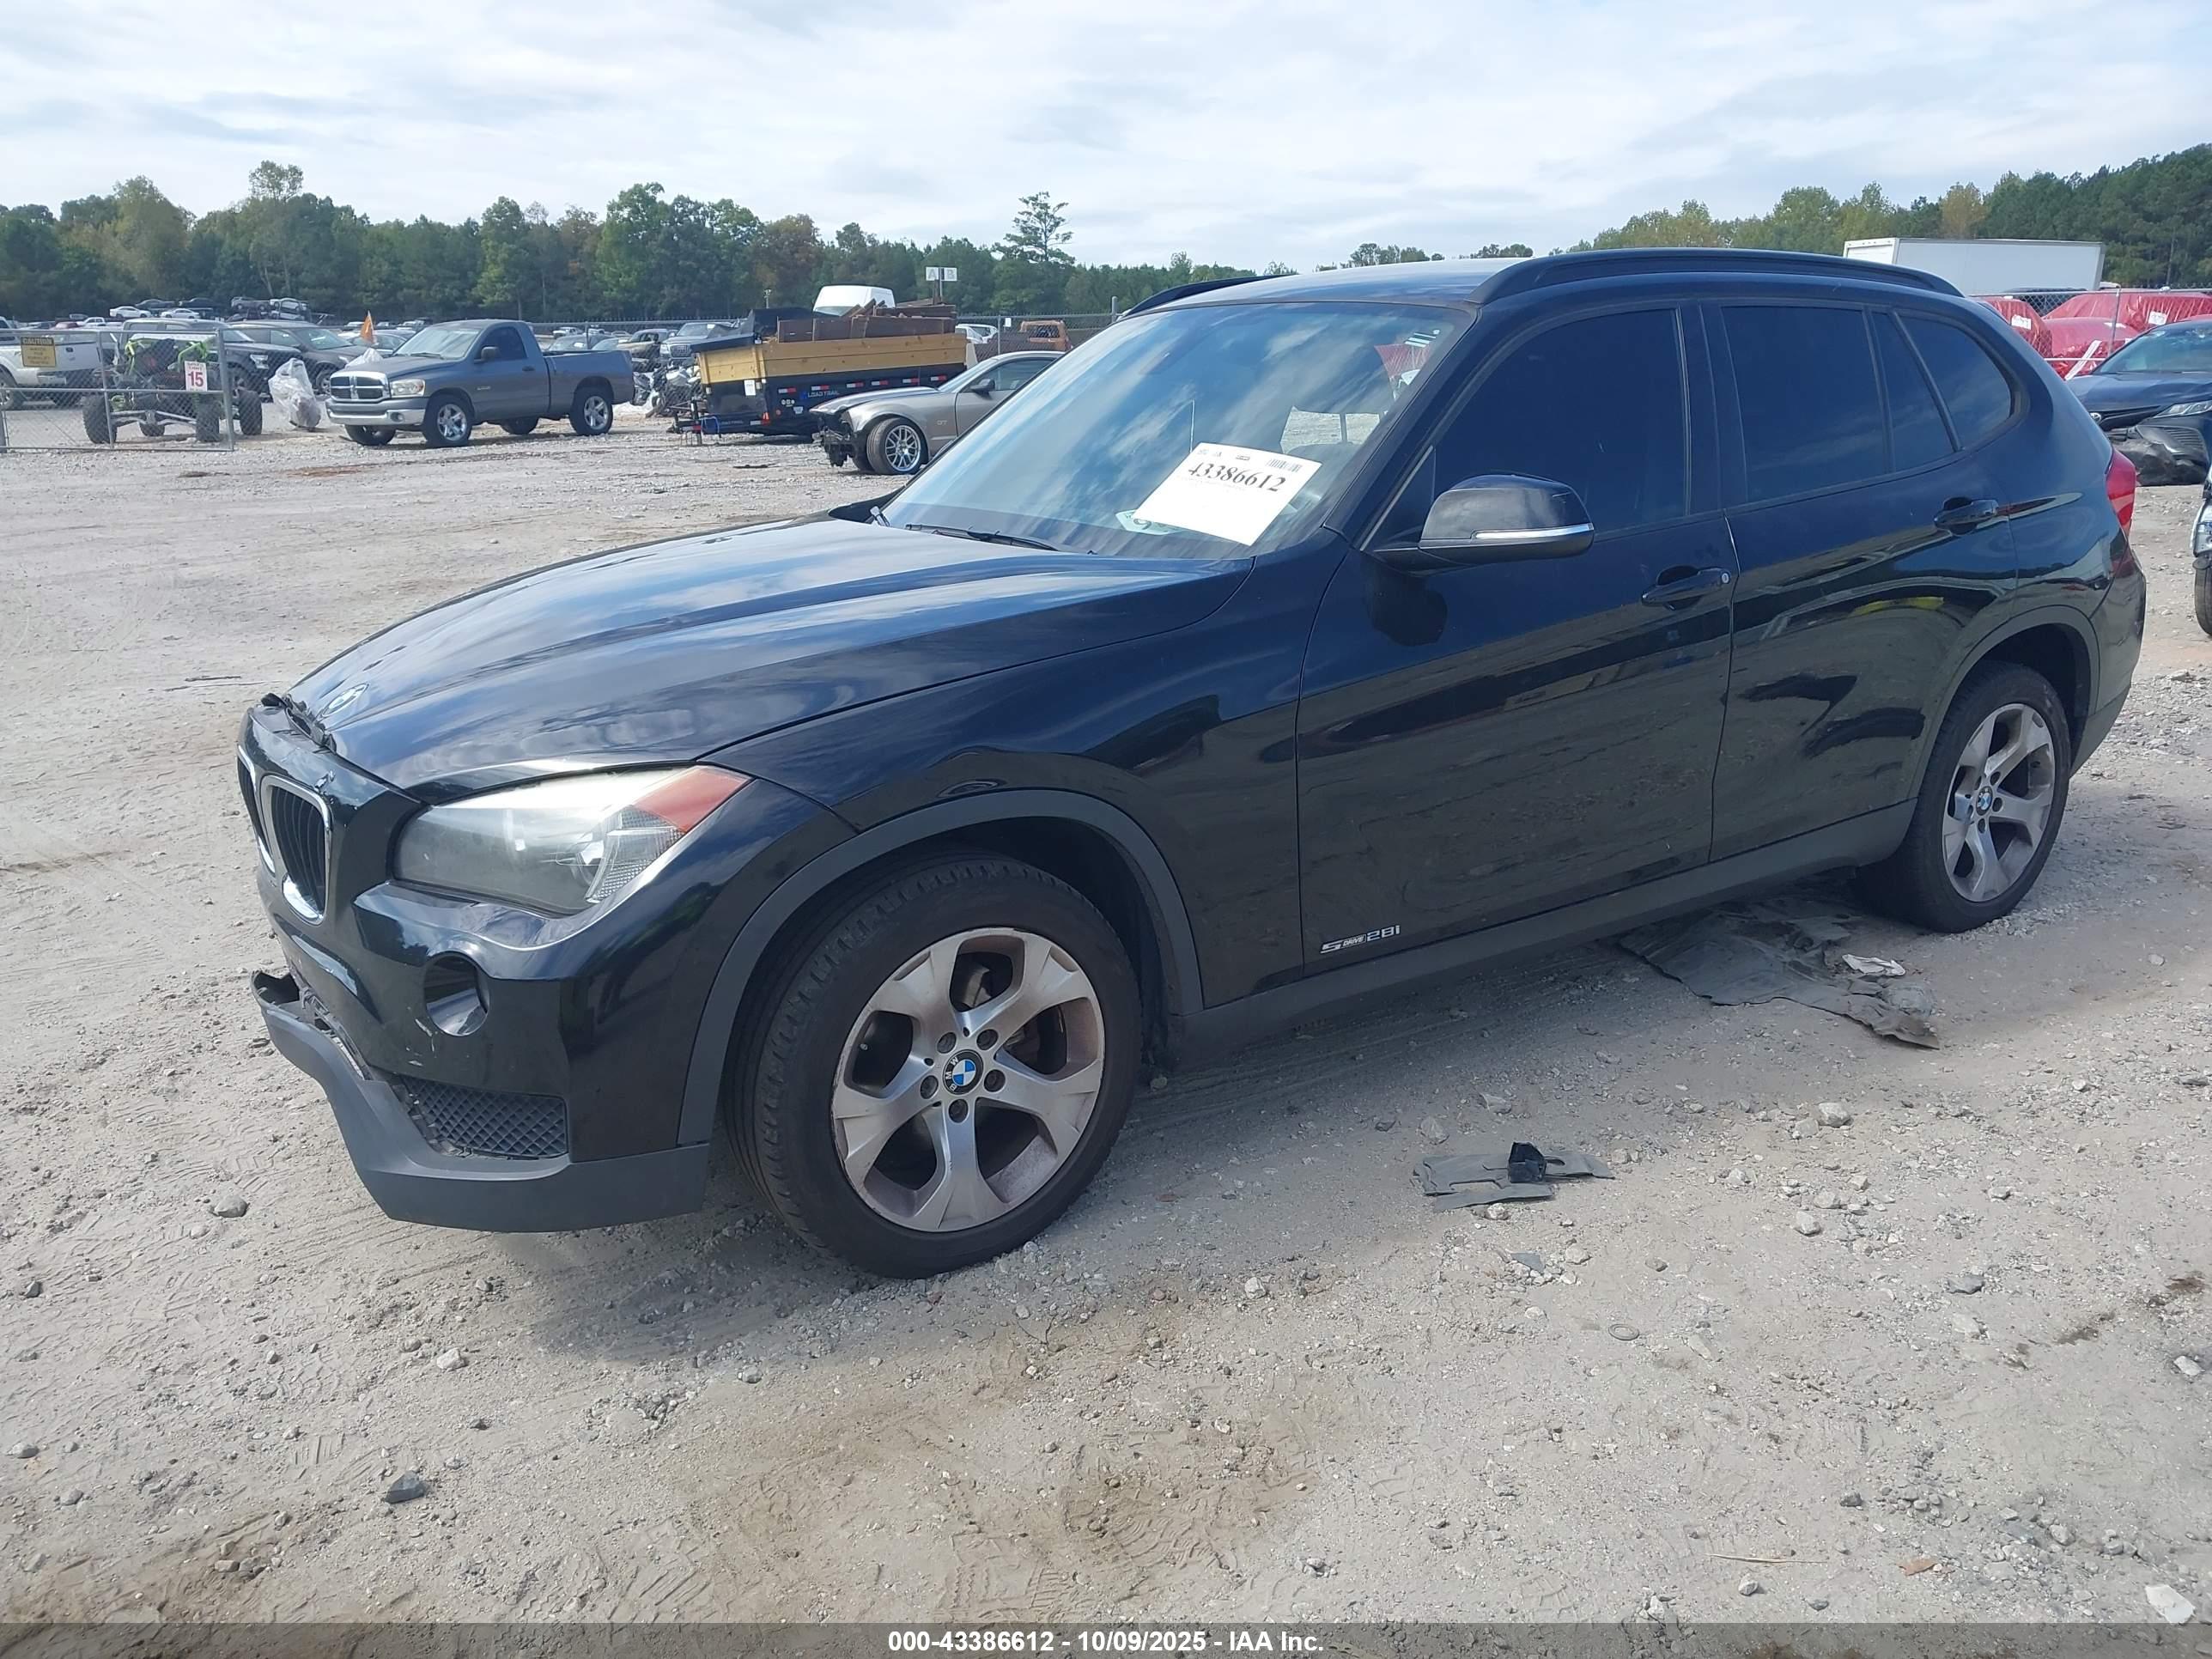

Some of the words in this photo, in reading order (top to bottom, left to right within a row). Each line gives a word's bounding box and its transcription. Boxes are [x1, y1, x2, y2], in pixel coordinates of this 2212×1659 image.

[927, 269, 937, 279] A
[187, 371, 204, 387] 15
[1188, 461, 1286, 492] 43386612
